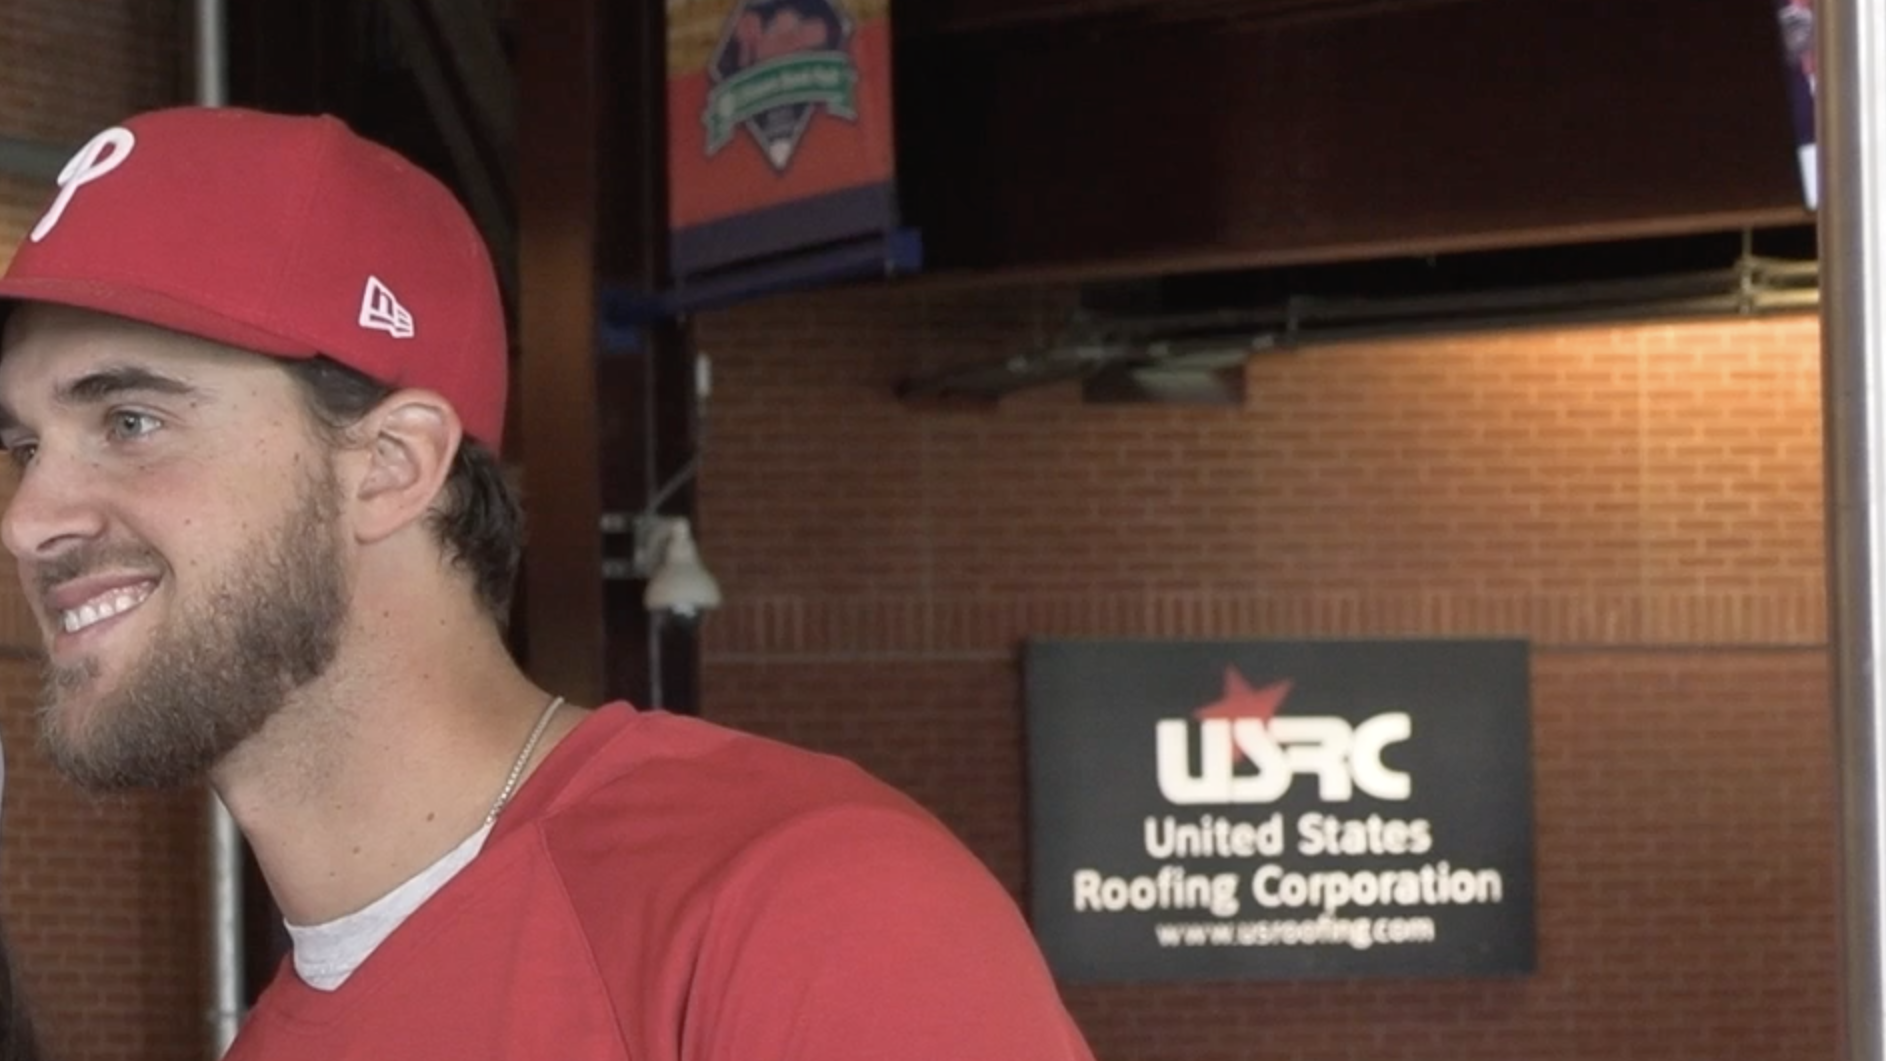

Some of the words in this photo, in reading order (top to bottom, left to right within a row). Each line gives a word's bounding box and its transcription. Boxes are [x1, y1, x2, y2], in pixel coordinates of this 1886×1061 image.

[31, 127, 135, 242] P
[1156, 712, 1412, 805] USRC
[1144, 811, 1284, 858] United
[1296, 811, 1433, 855] States
[1073, 866, 1240, 917] Roofing
[1252, 860, 1503, 914] Corporation
[1155, 914, 1436, 949] www.usroofing.com
